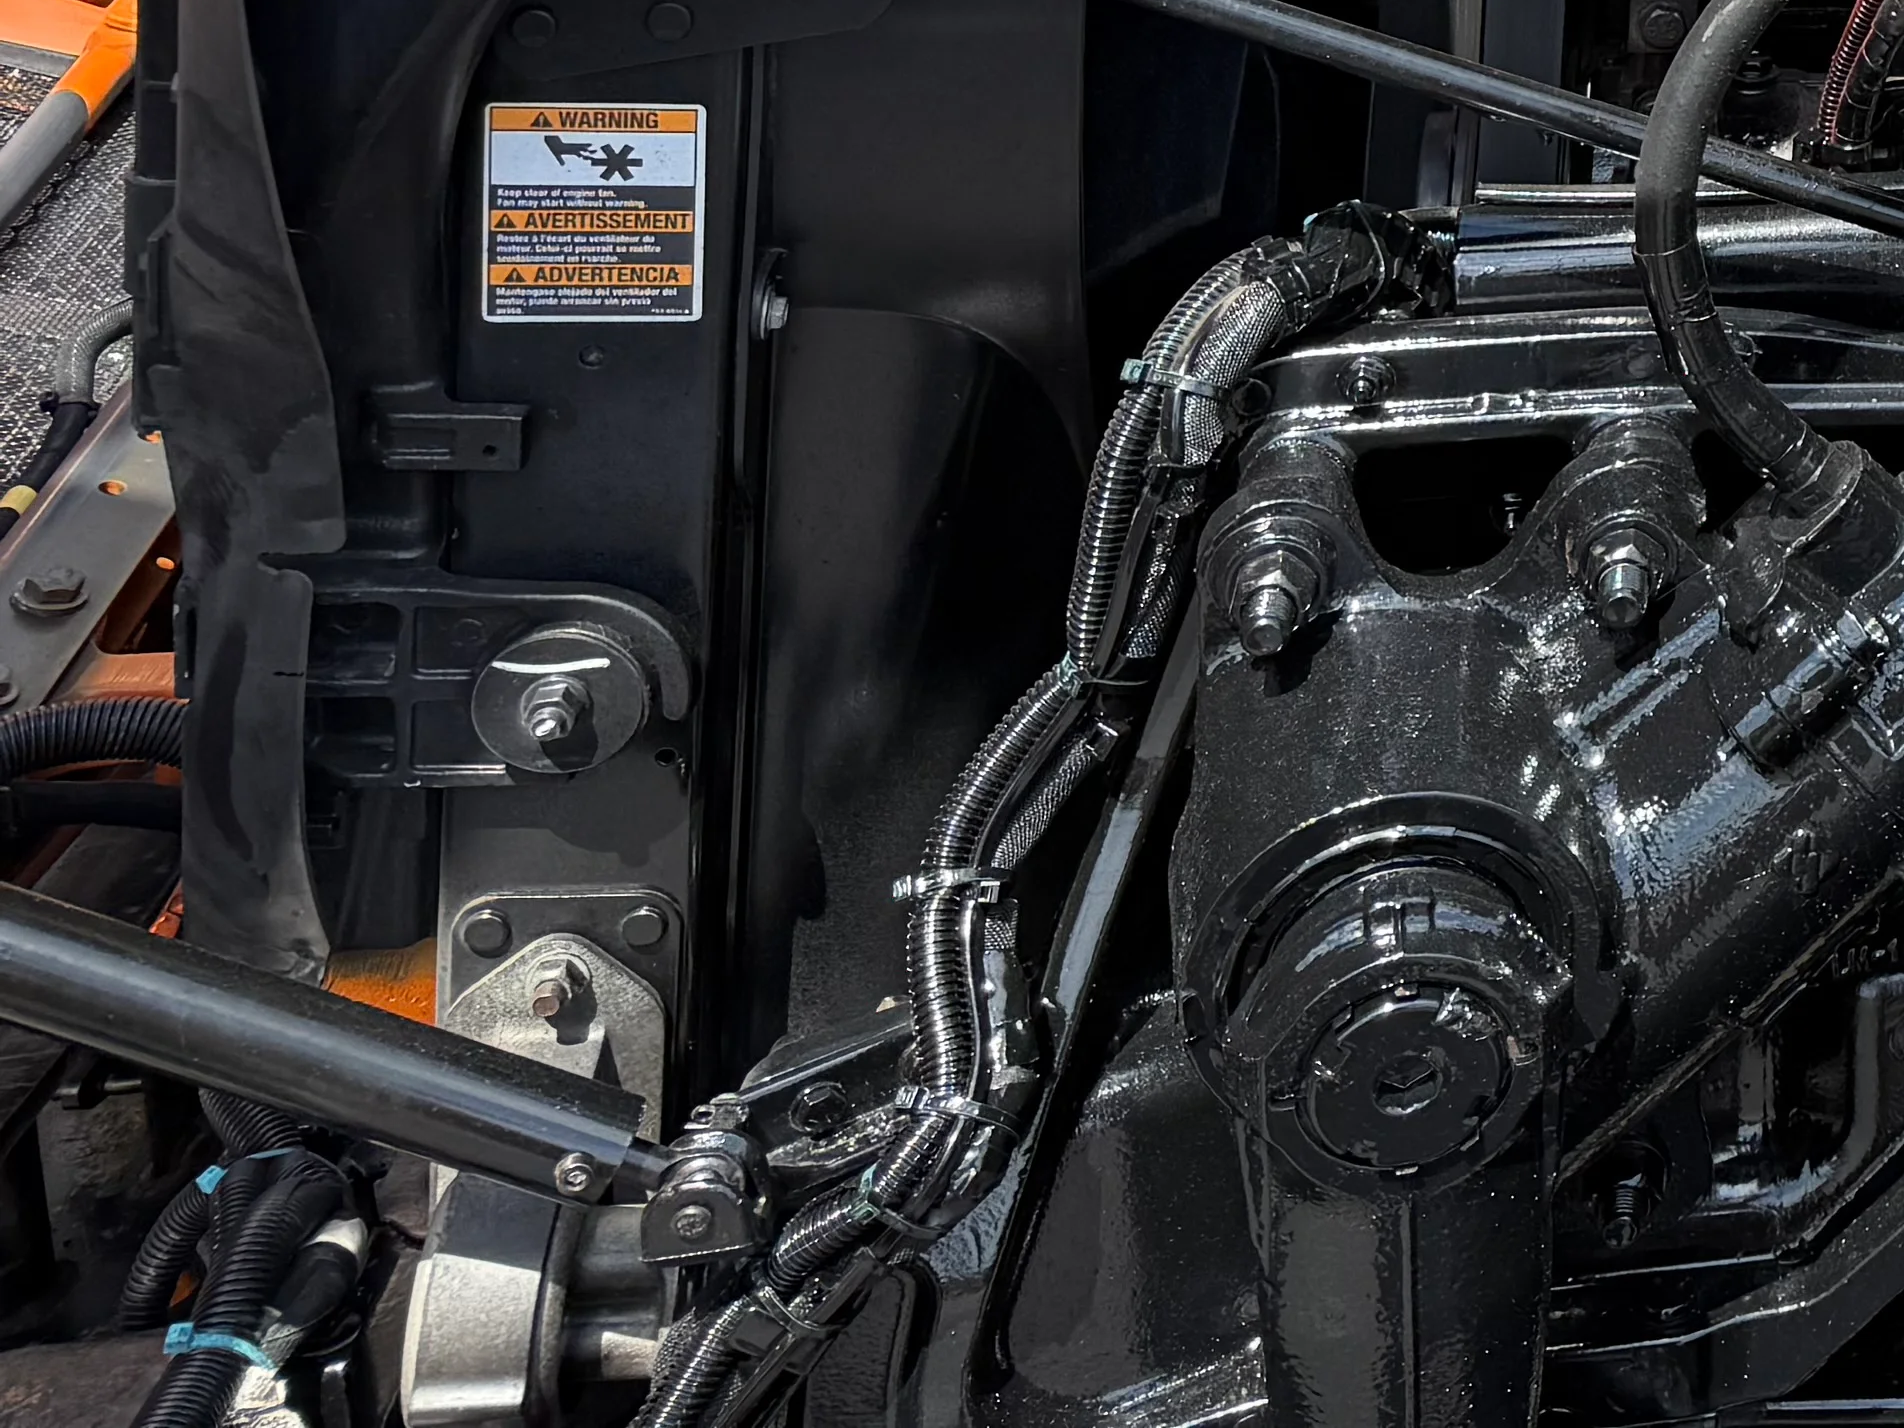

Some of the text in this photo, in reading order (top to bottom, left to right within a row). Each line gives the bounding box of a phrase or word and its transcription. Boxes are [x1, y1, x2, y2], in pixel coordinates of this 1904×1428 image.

[559, 111, 659, 129] WARNING
[524, 213, 690, 229] AVERTISSEMENT
[533, 267, 679, 283] ADVERTENCIA
